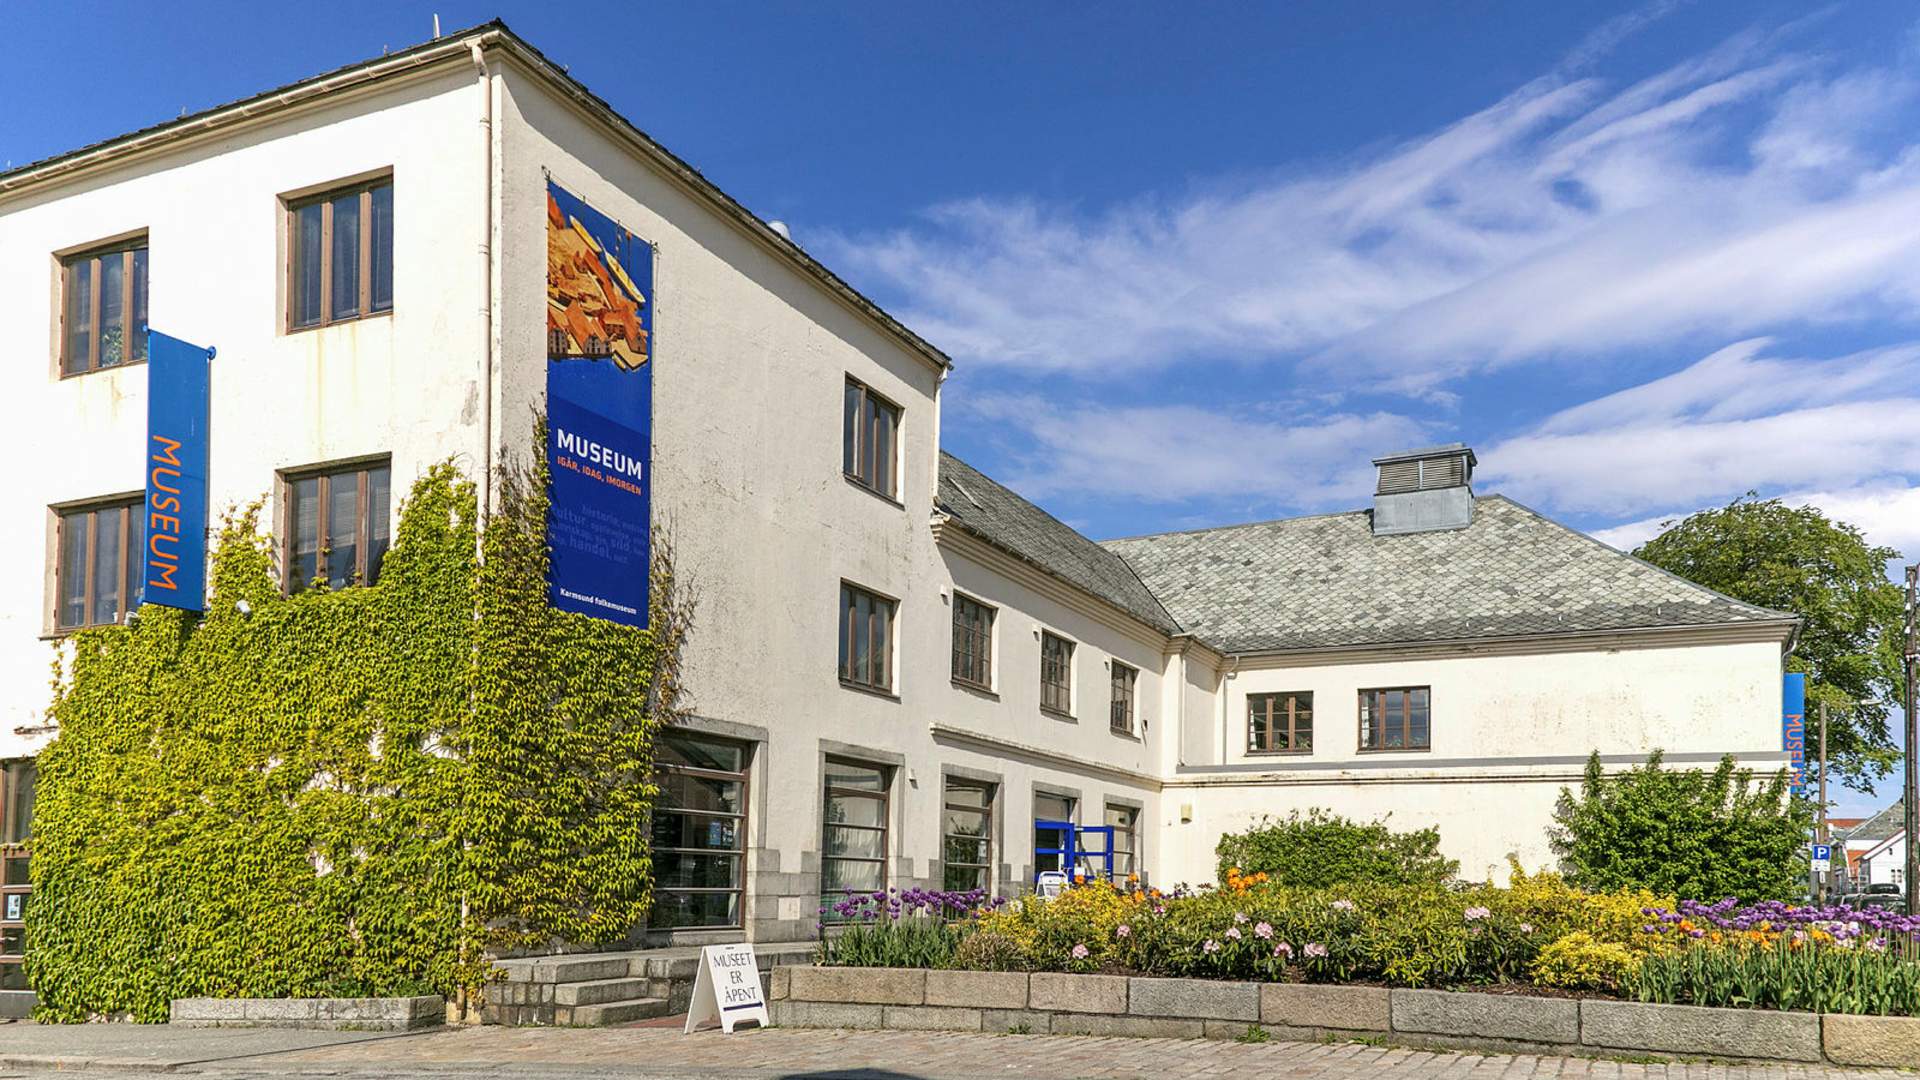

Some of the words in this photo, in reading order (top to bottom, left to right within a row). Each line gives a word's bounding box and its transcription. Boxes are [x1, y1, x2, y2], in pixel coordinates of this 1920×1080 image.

[557, 428, 642, 480] MUSEUM
[557, 455, 580, 473] IGÅR,
[582, 465, 604, 482] IDAG,
[606, 474, 642, 496] IMORGEN
[149, 435, 182, 590] MUSEUM
[560, 587, 594, 604] Karmsund
[1817, 847, 1828, 859] P
[714, 952, 752, 968] MUSEET
[730, 970, 743, 985] ER
[725, 986, 757, 1002] ÅPENT
